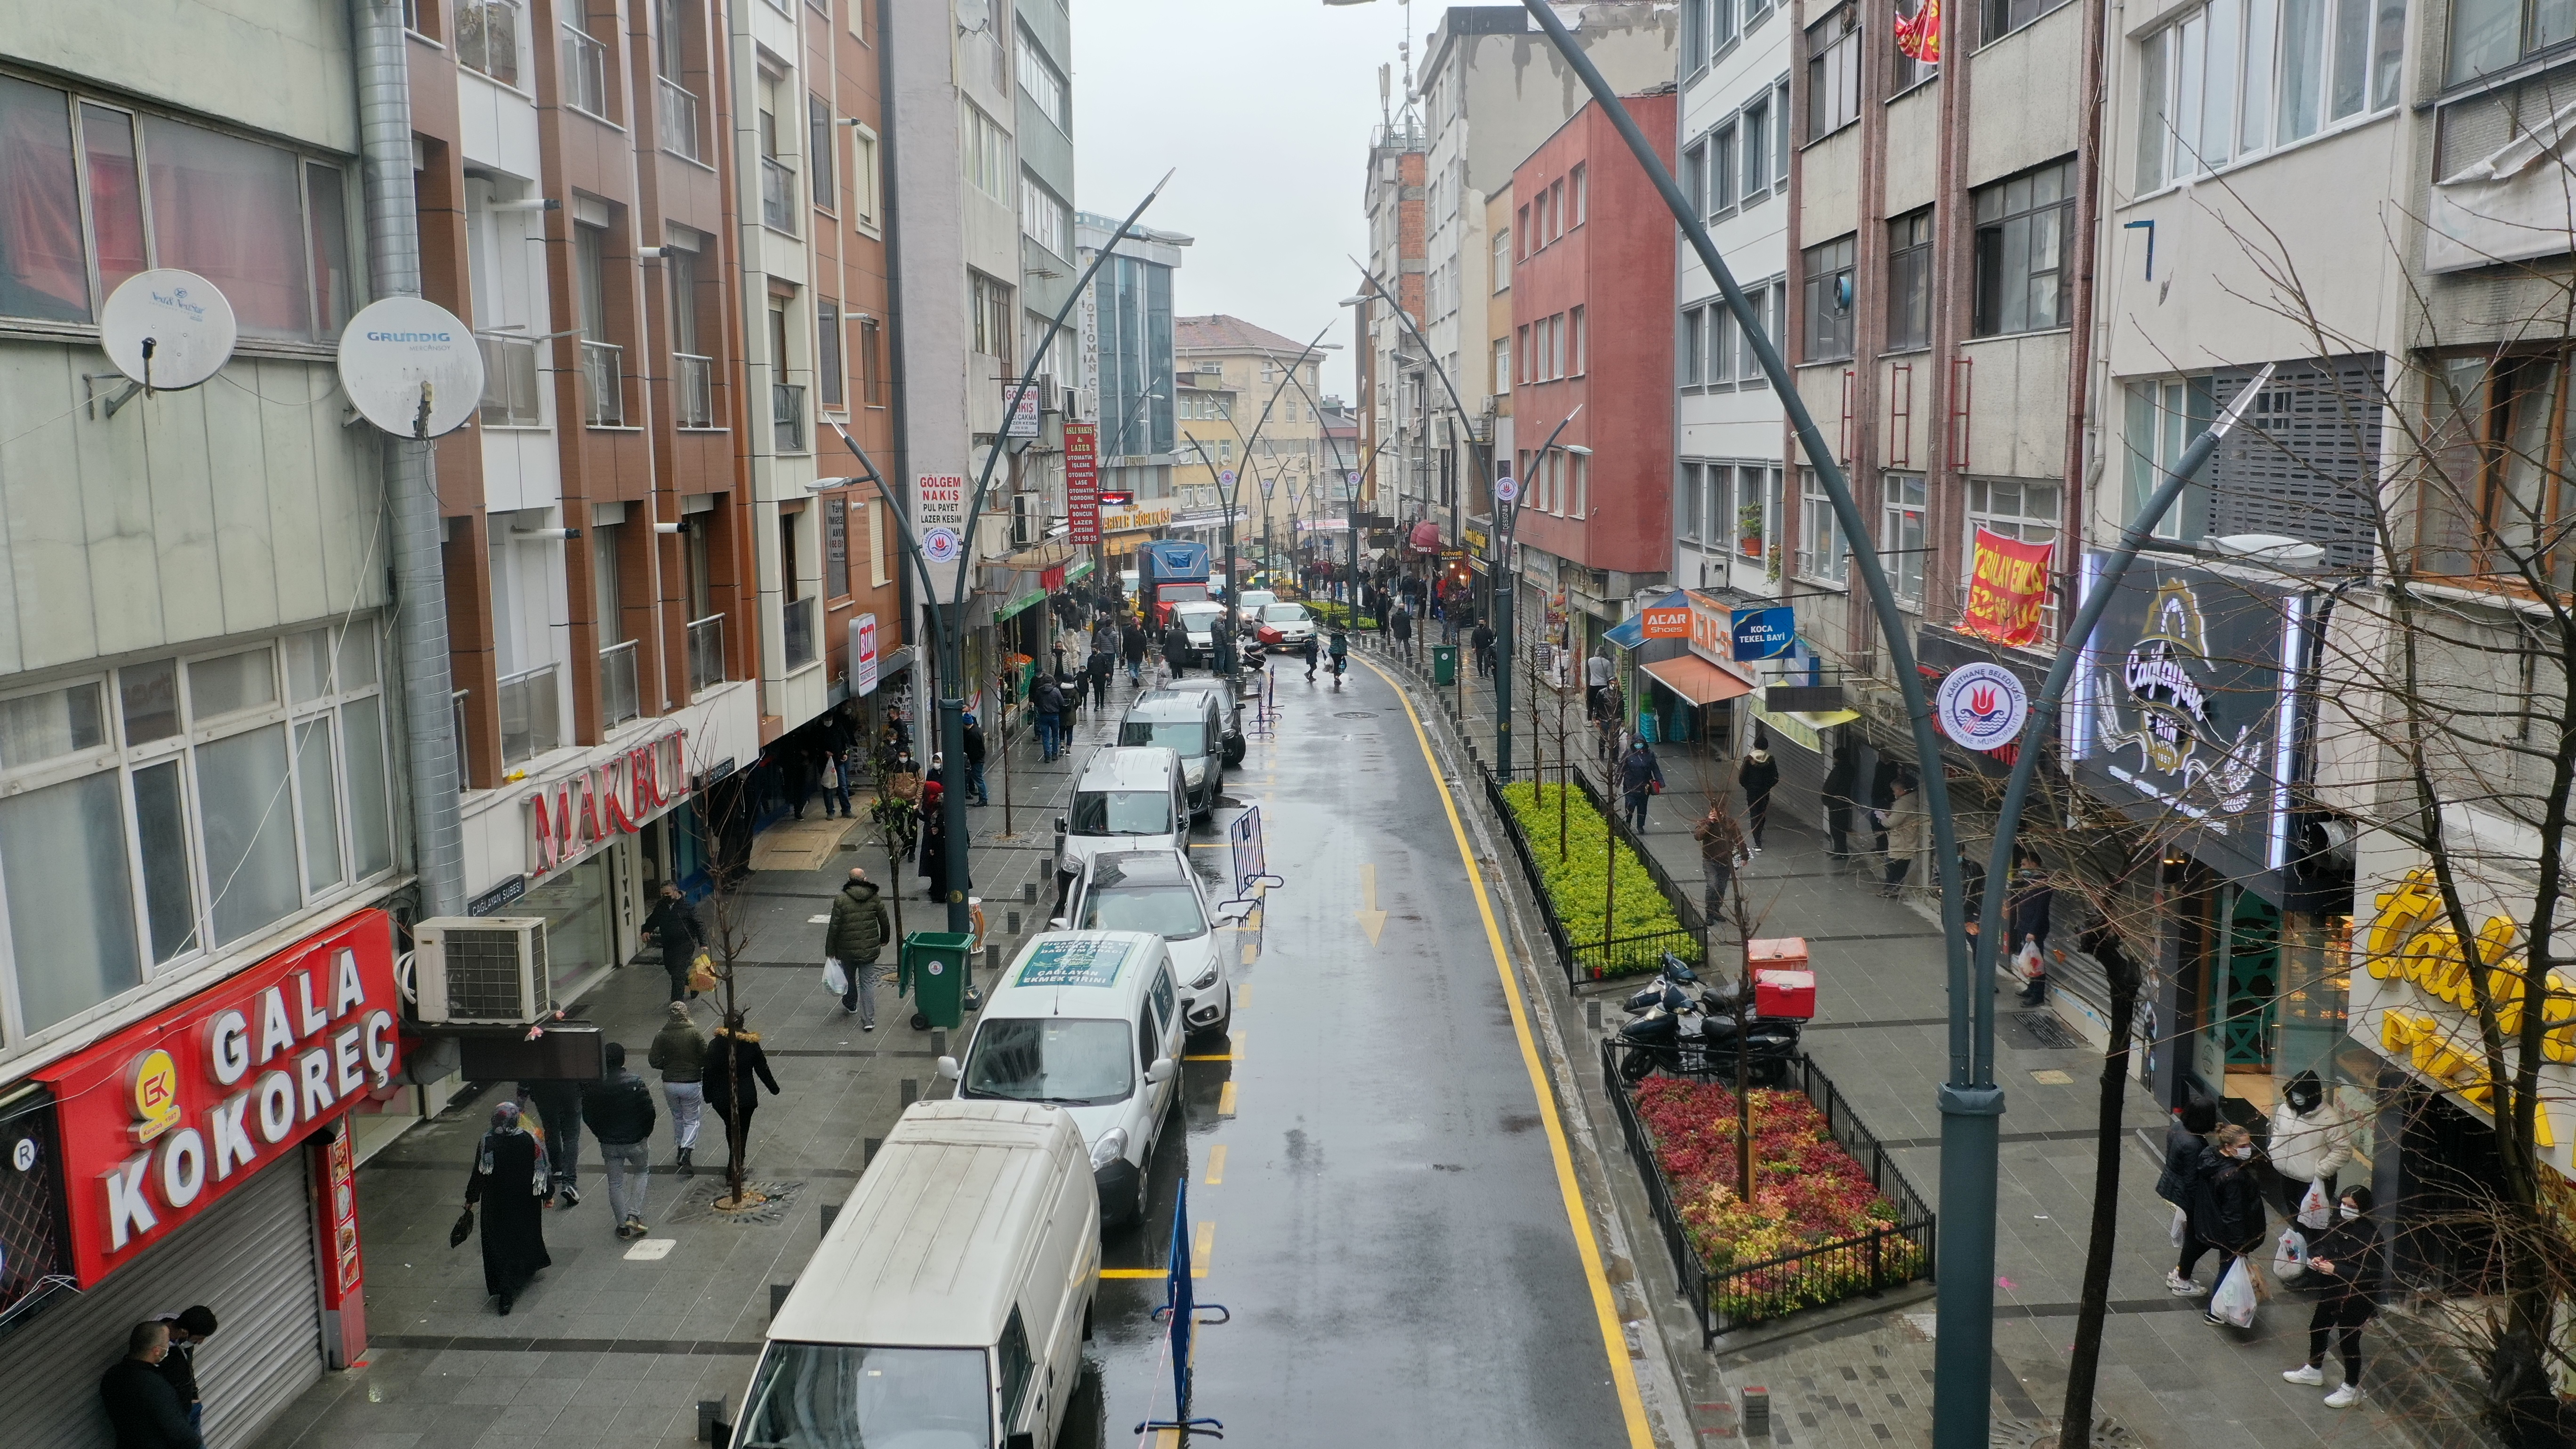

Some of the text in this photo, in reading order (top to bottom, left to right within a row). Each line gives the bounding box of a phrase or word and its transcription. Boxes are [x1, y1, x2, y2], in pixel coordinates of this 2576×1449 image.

[367, 331, 450, 342] GRUNDIG
[1006, 387, 1037, 400] GÖGEM
[1009, 402, 1033, 414] AKIŞ
[1078, 426, 1092, 435] NAKIŞ
[920, 475, 960, 488] GÖLGEM
[923, 490, 959, 502] NAKIŞ
[923, 503, 958, 512] PUL PAYET
[921, 513, 962, 523] LAZER KESİM
[1647, 614, 1686, 625] ACAR
[1750, 625, 1773, 633] KOCA
[1739, 632, 1785, 643] TEKEL BAYİ
[1988, 669, 2022, 701] BELEDİYESİ
[1977, 712, 2021, 746] MUNICIPALITY
[522, 728, 691, 879] MAKBUL
[203, 946, 364, 1086] GALA
[96, 1008, 394, 1254] KOKOREÇ
